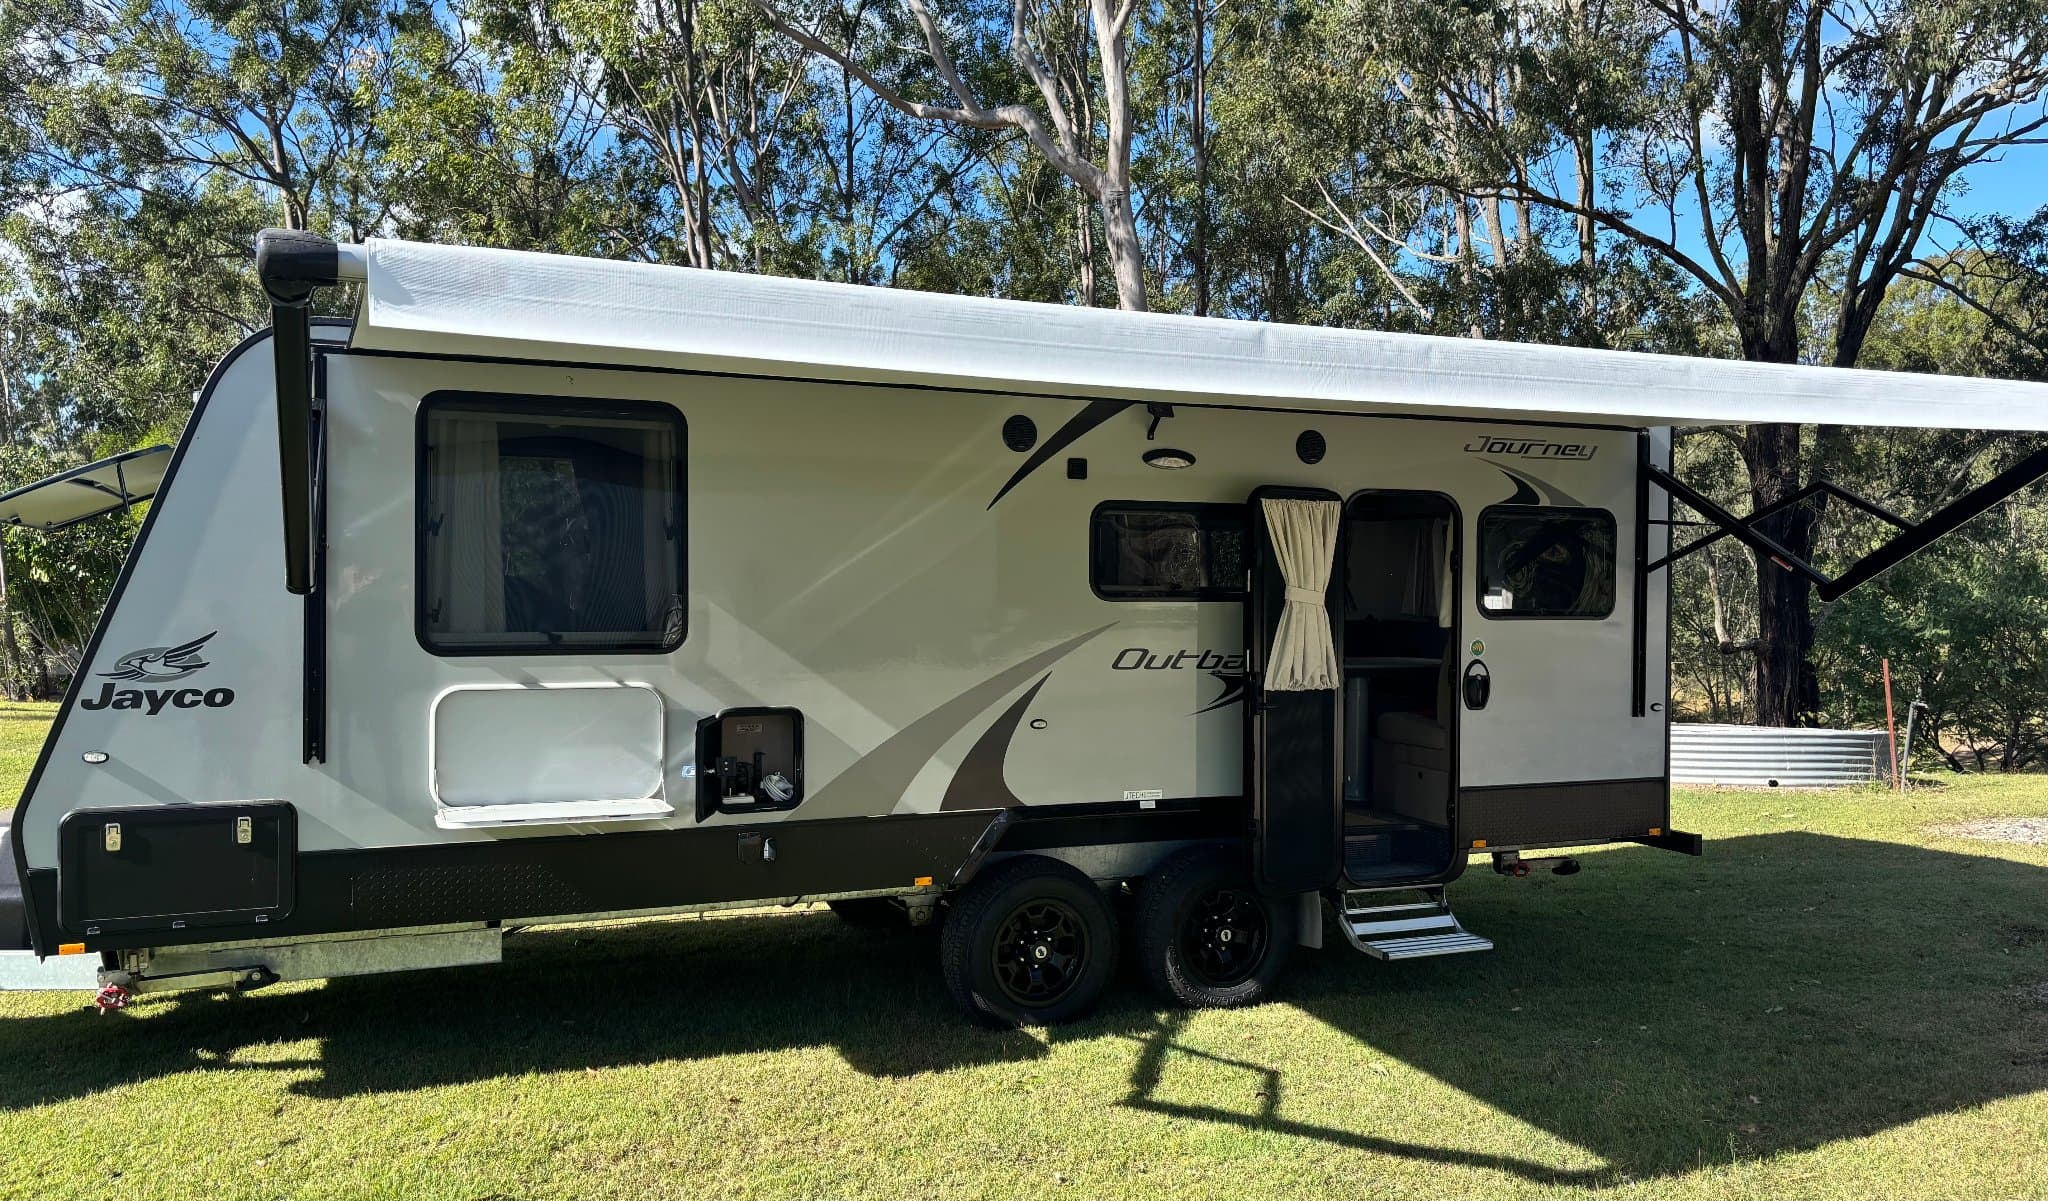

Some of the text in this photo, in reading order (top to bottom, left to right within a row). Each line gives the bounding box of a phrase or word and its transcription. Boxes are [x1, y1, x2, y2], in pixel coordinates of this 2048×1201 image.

[1463, 435, 1598, 461] Journey
[1111, 648, 1244, 671] Outba
[80, 683, 235, 716] Jayco
